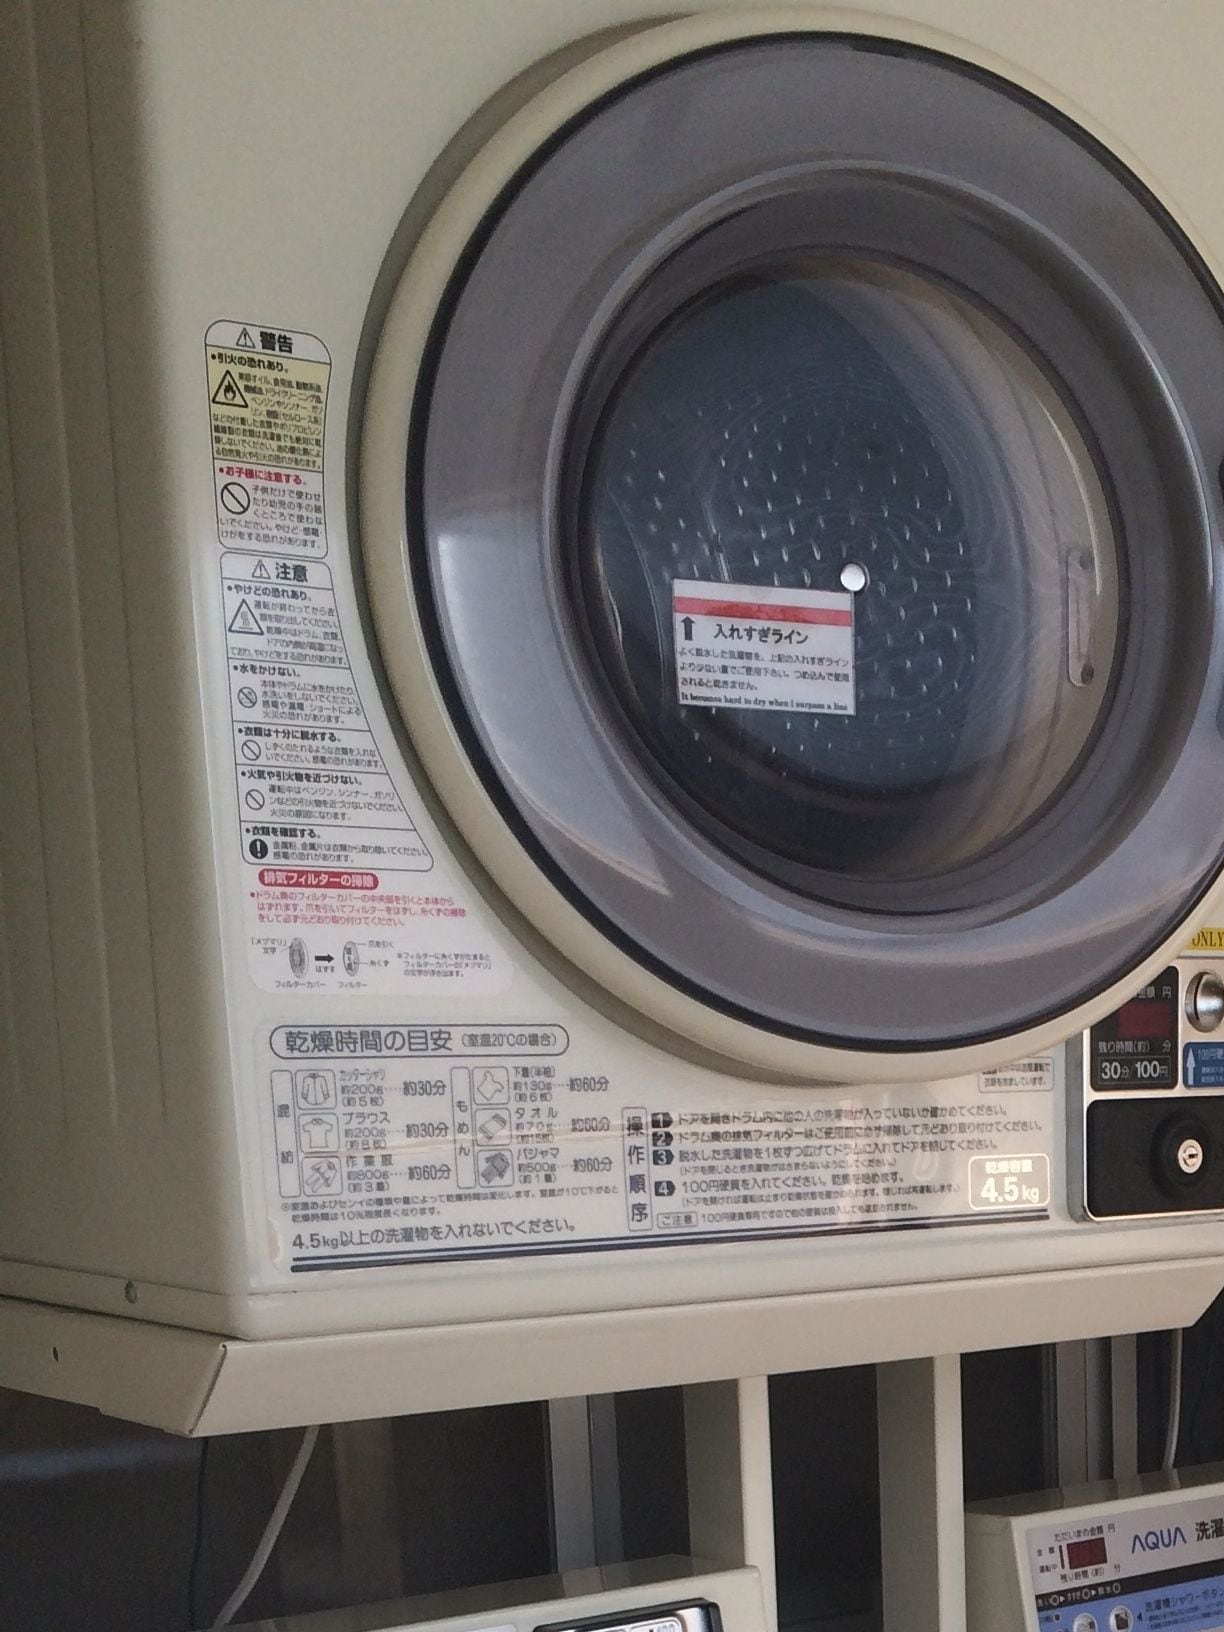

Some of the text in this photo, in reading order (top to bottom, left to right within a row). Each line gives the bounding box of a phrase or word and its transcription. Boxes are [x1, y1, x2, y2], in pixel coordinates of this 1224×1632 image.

[259, 331, 294, 354] 警告
[275, 562, 309, 583] 注意
[713, 624, 809, 645] 入れすぎライン
[724, 695, 742, 704] hard
[753, 696, 766, 708] dry
[1162, 986, 1172, 999] 円
[285, 1029, 453, 1053] 乾燥時間の目安
[1135, 1061, 1168, 1078] 100円
[403, 1080, 447, 1096] 約30分
[569, 1076, 609, 1092] 約60分
[406, 1122, 449, 1138] 約30分
[408, 1164, 452, 1181] 約60分
[573, 1157, 613, 1172] 約60分
[626, 1115, 648, 1222] 操作順序
[1131, 1526, 1187, 1554] AQUA
